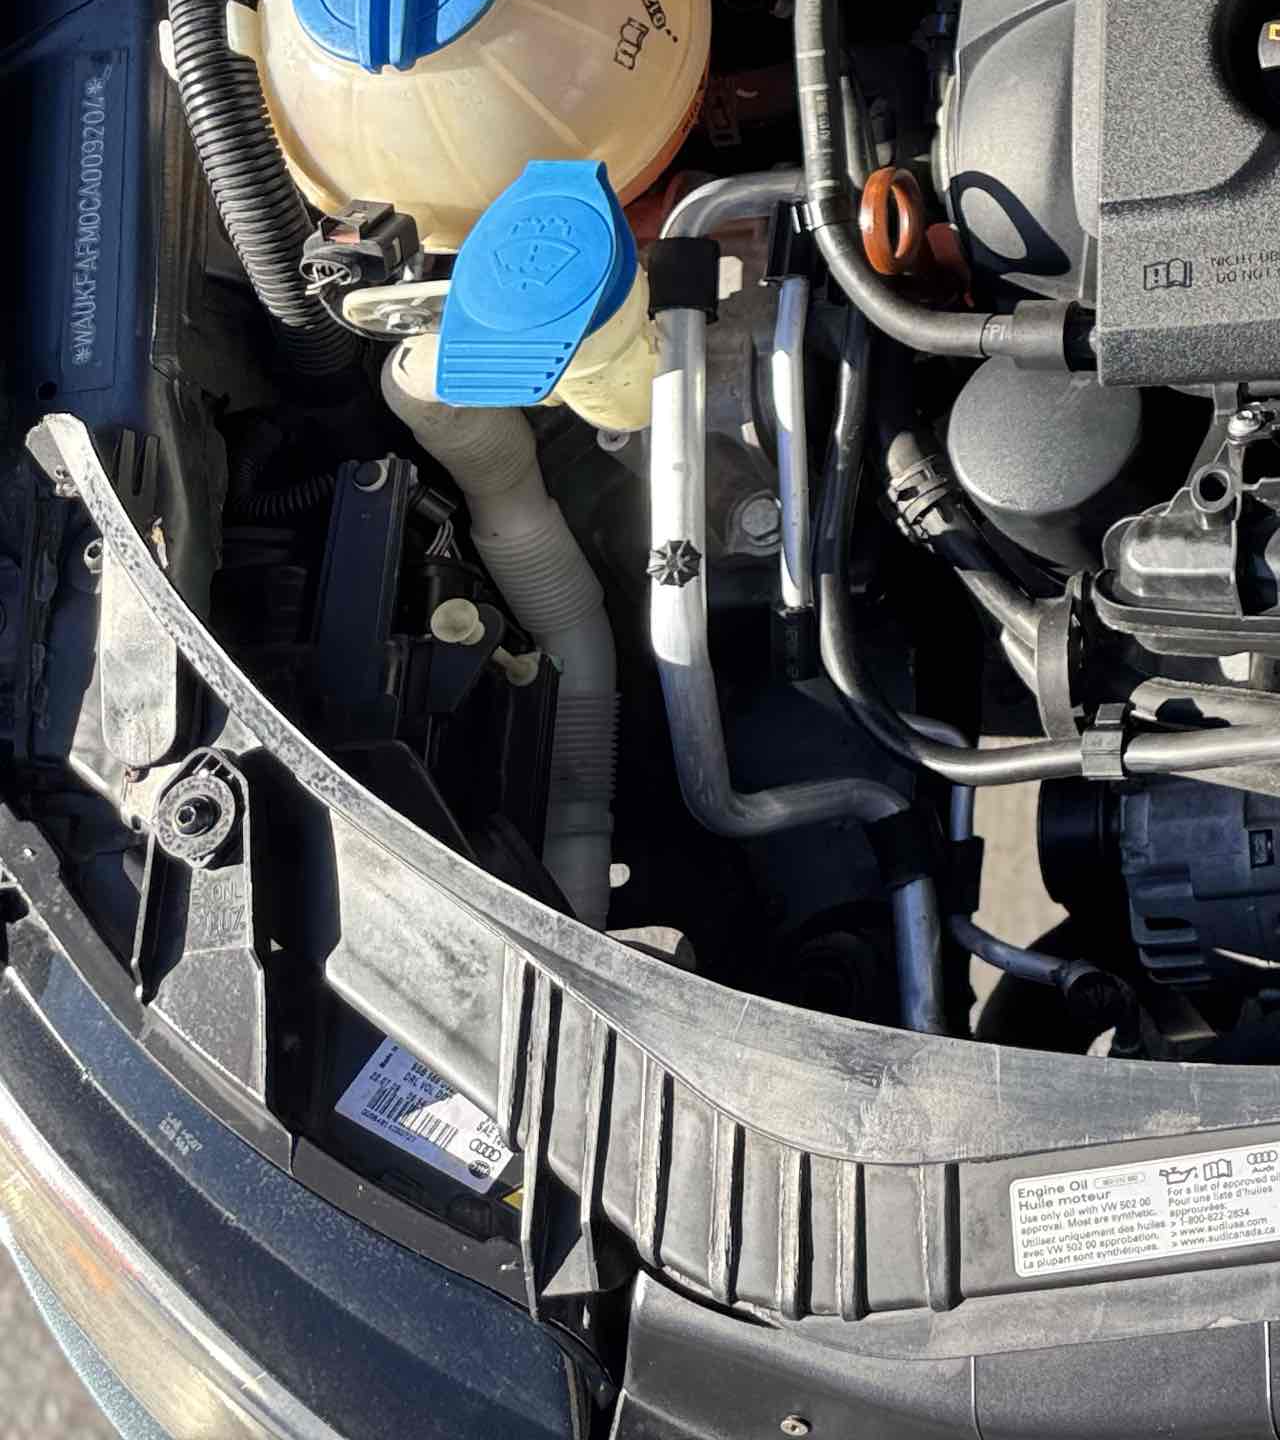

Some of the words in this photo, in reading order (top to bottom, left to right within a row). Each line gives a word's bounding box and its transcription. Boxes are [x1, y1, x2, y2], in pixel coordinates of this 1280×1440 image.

[1017, 1182, 1065, 1200] Engine
[1069, 1178, 1088, 1192] Oil
[1167, 1185, 1182, 1197] For
[1193, 1182, 1208, 1193] list
[1209, 1180, 1220, 1190] of
[1222, 1173, 1268, 1190] approved
[1018, 1197, 1053, 1211] Huile
[1057, 1189, 1111, 1206] moteur
[1167, 1195, 1190, 1207] Pour
[1192, 1193, 1211, 1203] une
[1212, 1189, 1233, 1200] liste
[1019, 1213, 1037, 1224] Use
[1040, 1209, 1060, 1222] only
[1063, 1207, 1075, 1218] oil
[1078, 1204, 1098, 1216] with
[1100, 1201, 1118, 1212] VW
[1119, 1198, 1136, 1210] 502
[1138, 1195, 1152, 1207] 00
[1058, 1226, 1114, 1244] uniquement
[1117, 1223, 1134, 1234] des
[1137, 1219, 1165, 1231] huiles
[1067, 1216, 1091, 1228] Most
[1094, 1215, 1109, 1224] are
[1047, 1244, 1063, 1254] VW
[1066, 1241, 1083, 1252] 502
[1085, 1238, 1097, 1249] 00
[1023, 1260, 1033, 1269] La
[1036, 1254, 1070, 1268] plupart
[1073, 1251, 1094, 1261] sont
